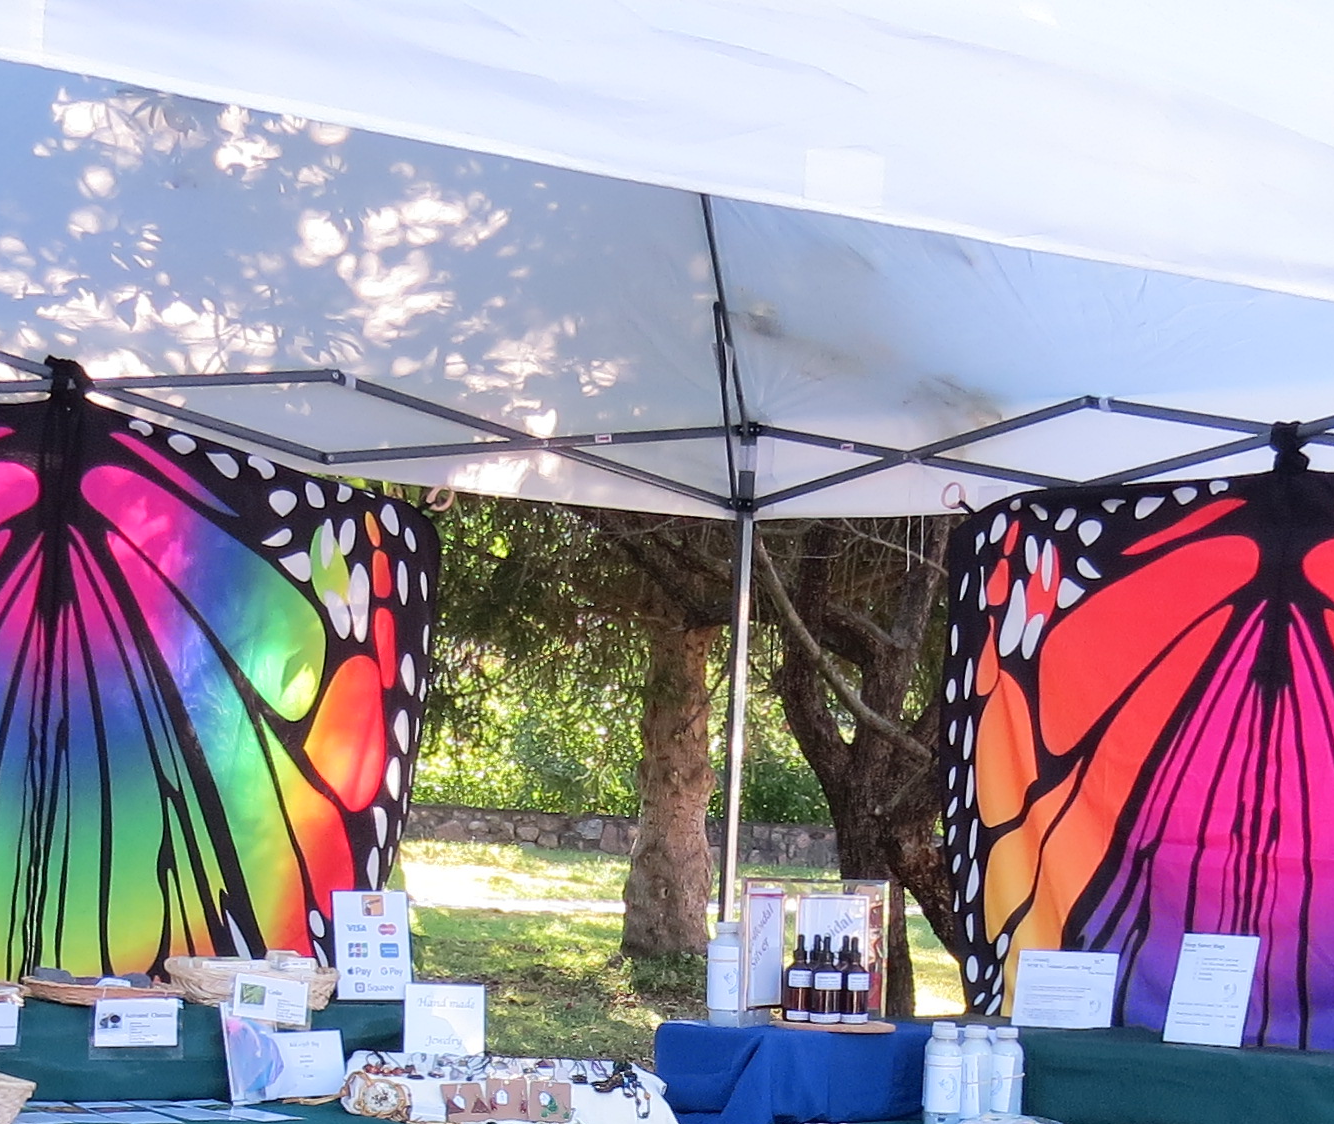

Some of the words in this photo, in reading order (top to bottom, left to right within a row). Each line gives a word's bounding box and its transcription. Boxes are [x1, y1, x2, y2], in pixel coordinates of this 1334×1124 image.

[346, 924, 366, 932] VISA
[825, 912, 854, 938] oidal
[355, 967, 372, 978] Pay
[389, 967, 403, 976] Pay
[367, 982, 395, 992] Square
[417, 996, 448, 1008] Hand
[449, 998, 475, 1009] made
